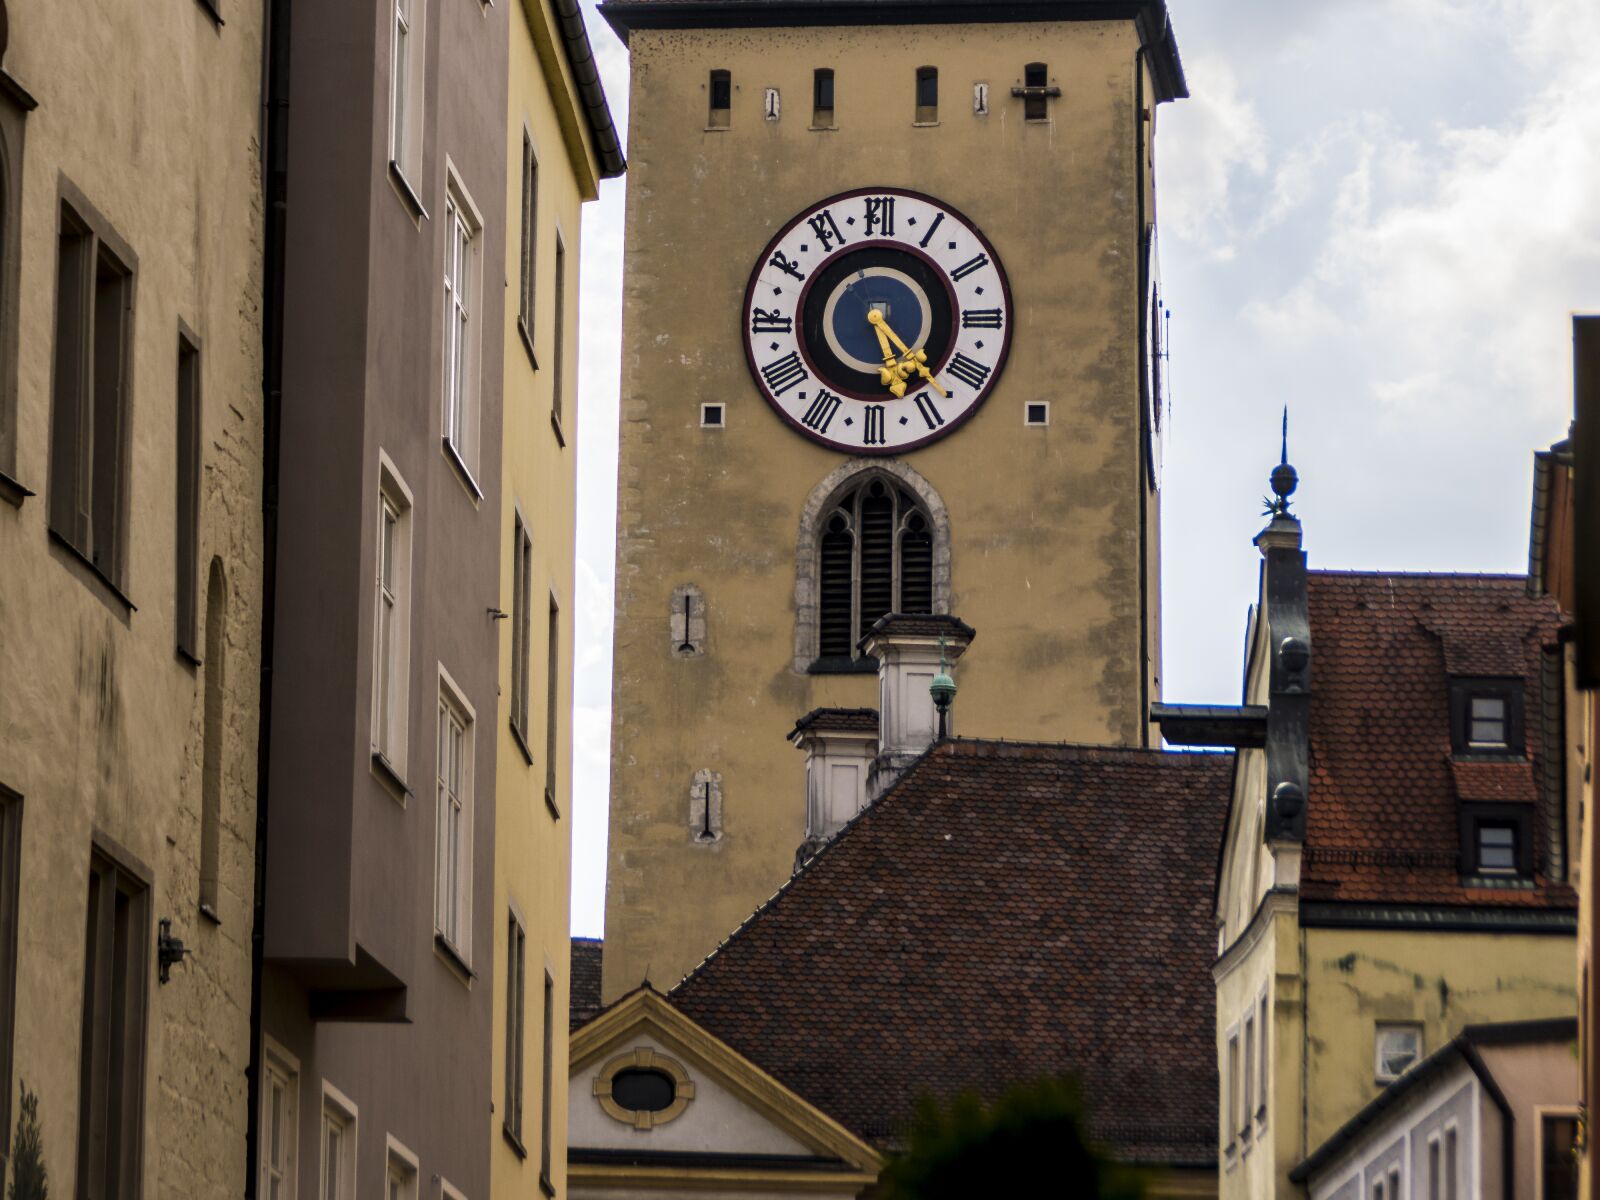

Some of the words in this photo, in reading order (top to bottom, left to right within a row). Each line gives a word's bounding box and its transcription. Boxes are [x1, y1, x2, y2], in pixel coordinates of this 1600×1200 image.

[807, 210, 846, 252] XI
[864, 197, 895, 237] XII
[919, 213, 944, 248] I
[769, 250, 805, 282] X
[950, 252, 990, 282] II
[962, 308, 1003, 329] III
[946, 352, 992, 390] IIII
